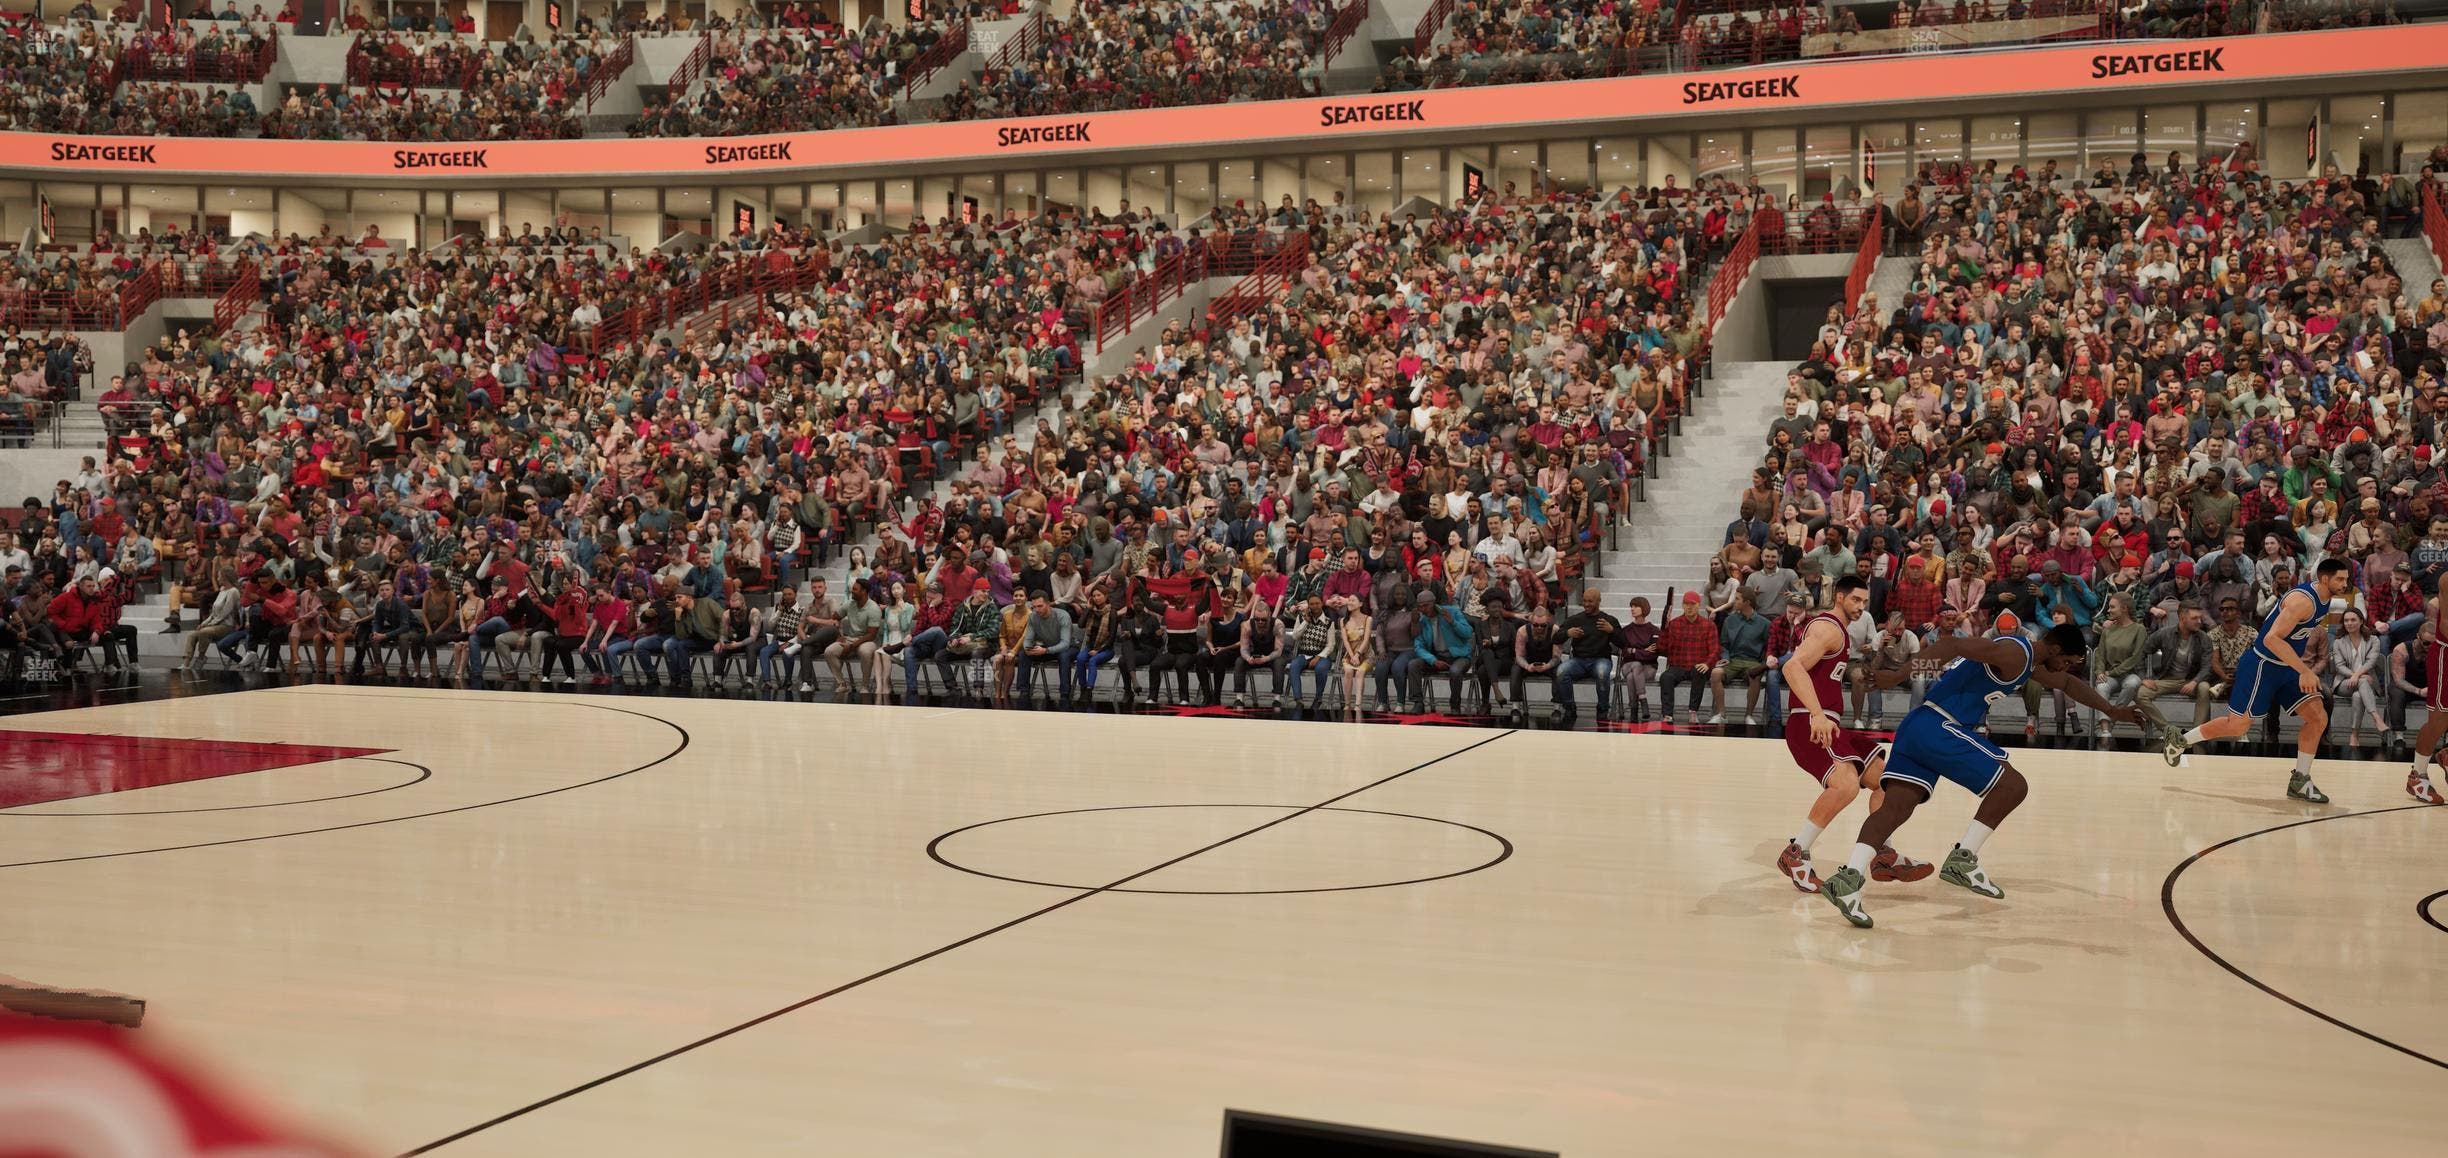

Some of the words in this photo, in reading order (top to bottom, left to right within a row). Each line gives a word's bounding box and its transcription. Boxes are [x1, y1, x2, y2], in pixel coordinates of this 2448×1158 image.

[2091, 47, 2225, 79] SEATGEEK
[1683, 75, 1800, 105] SEATGEEK
[1321, 99, 1425, 127] SEATGEEK
[998, 121, 1091, 147] SEATGEEK
[51, 142, 156, 164] SEATGEEK
[394, 149, 488, 169] SEATGEEK
[705, 141, 792, 164] SEATGEEK
